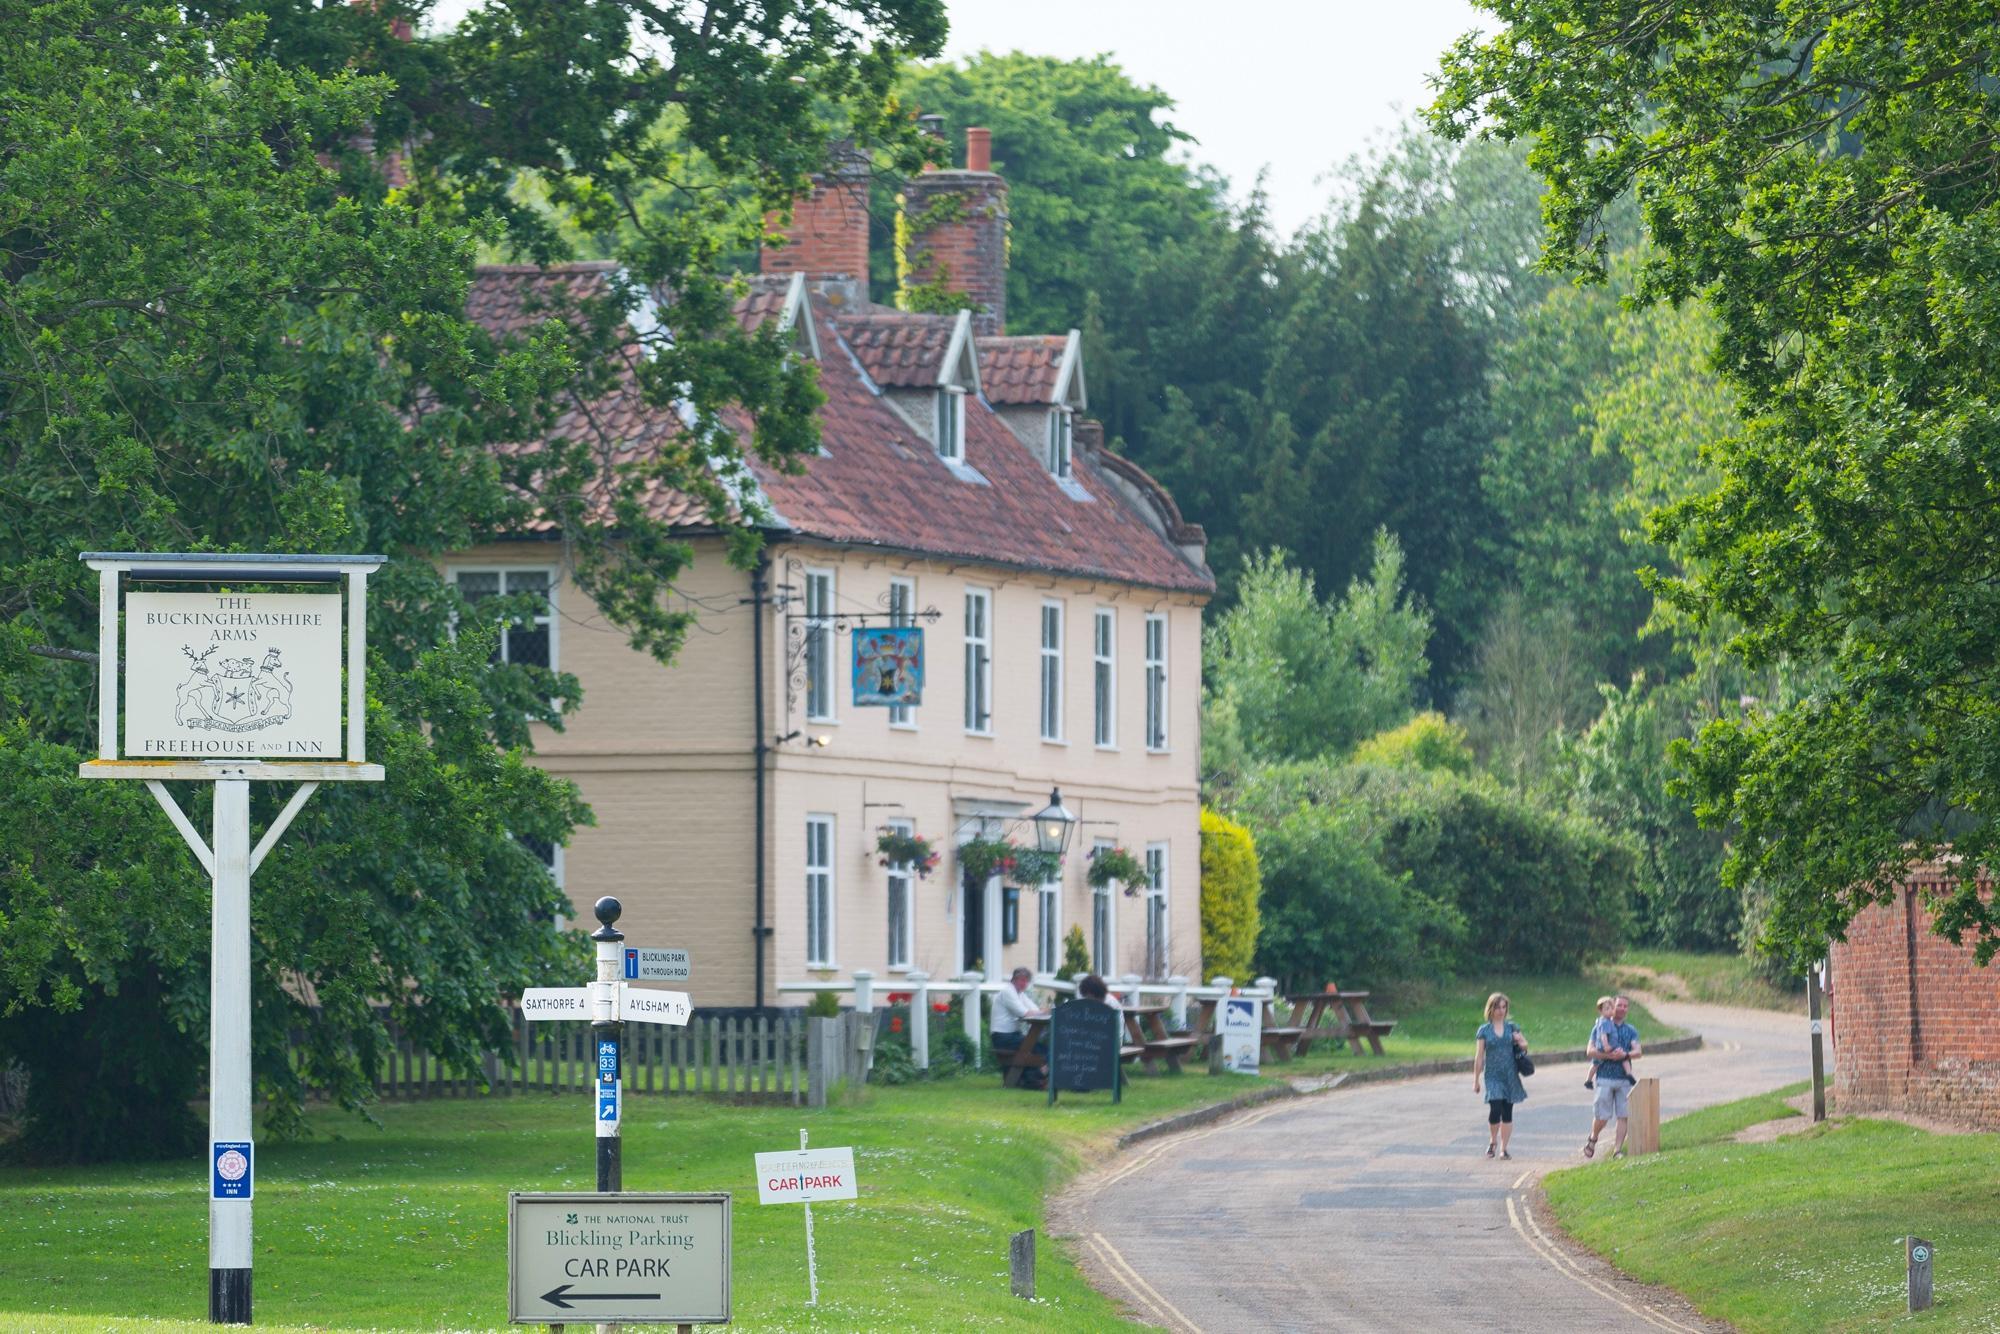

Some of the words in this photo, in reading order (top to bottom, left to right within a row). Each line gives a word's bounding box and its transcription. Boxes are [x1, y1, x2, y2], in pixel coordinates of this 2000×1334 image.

[216, 597, 251, 609] THE
[147, 613, 322, 626] BUCKINGHAMSHIRE
[210, 629, 257, 641] ARMS
[145, 740, 255, 752] FREEHOUSE
[287, 740, 323, 753] INN
[642, 952, 670, 962] BLICKLING
[671, 953, 686, 962] PARK
[642, 967, 649, 976] NO
[650, 967, 673, 976] THROUGH
[674, 968, 688, 977] ROAD
[526, 998, 575, 1010] SAXTHORPE
[579, 998, 585, 1009] 4
[630, 999, 670, 1013] AYLSHAM
[601, 1058, 615, 1068] 33
[768, 1177, 799, 1191] CAR
[805, 1175, 843, 1189] PARK
[584, 1215, 601, 1224] THE
[606, 1215, 656, 1224] NATIONAL
[661, 1214, 689, 1224] TRUST
[545, 1230, 623, 1250] Blickling
[629, 1230, 695, 1250] Parking
[565, 1258, 609, 1278] CAR
[616, 1258, 671, 1278] PARK
